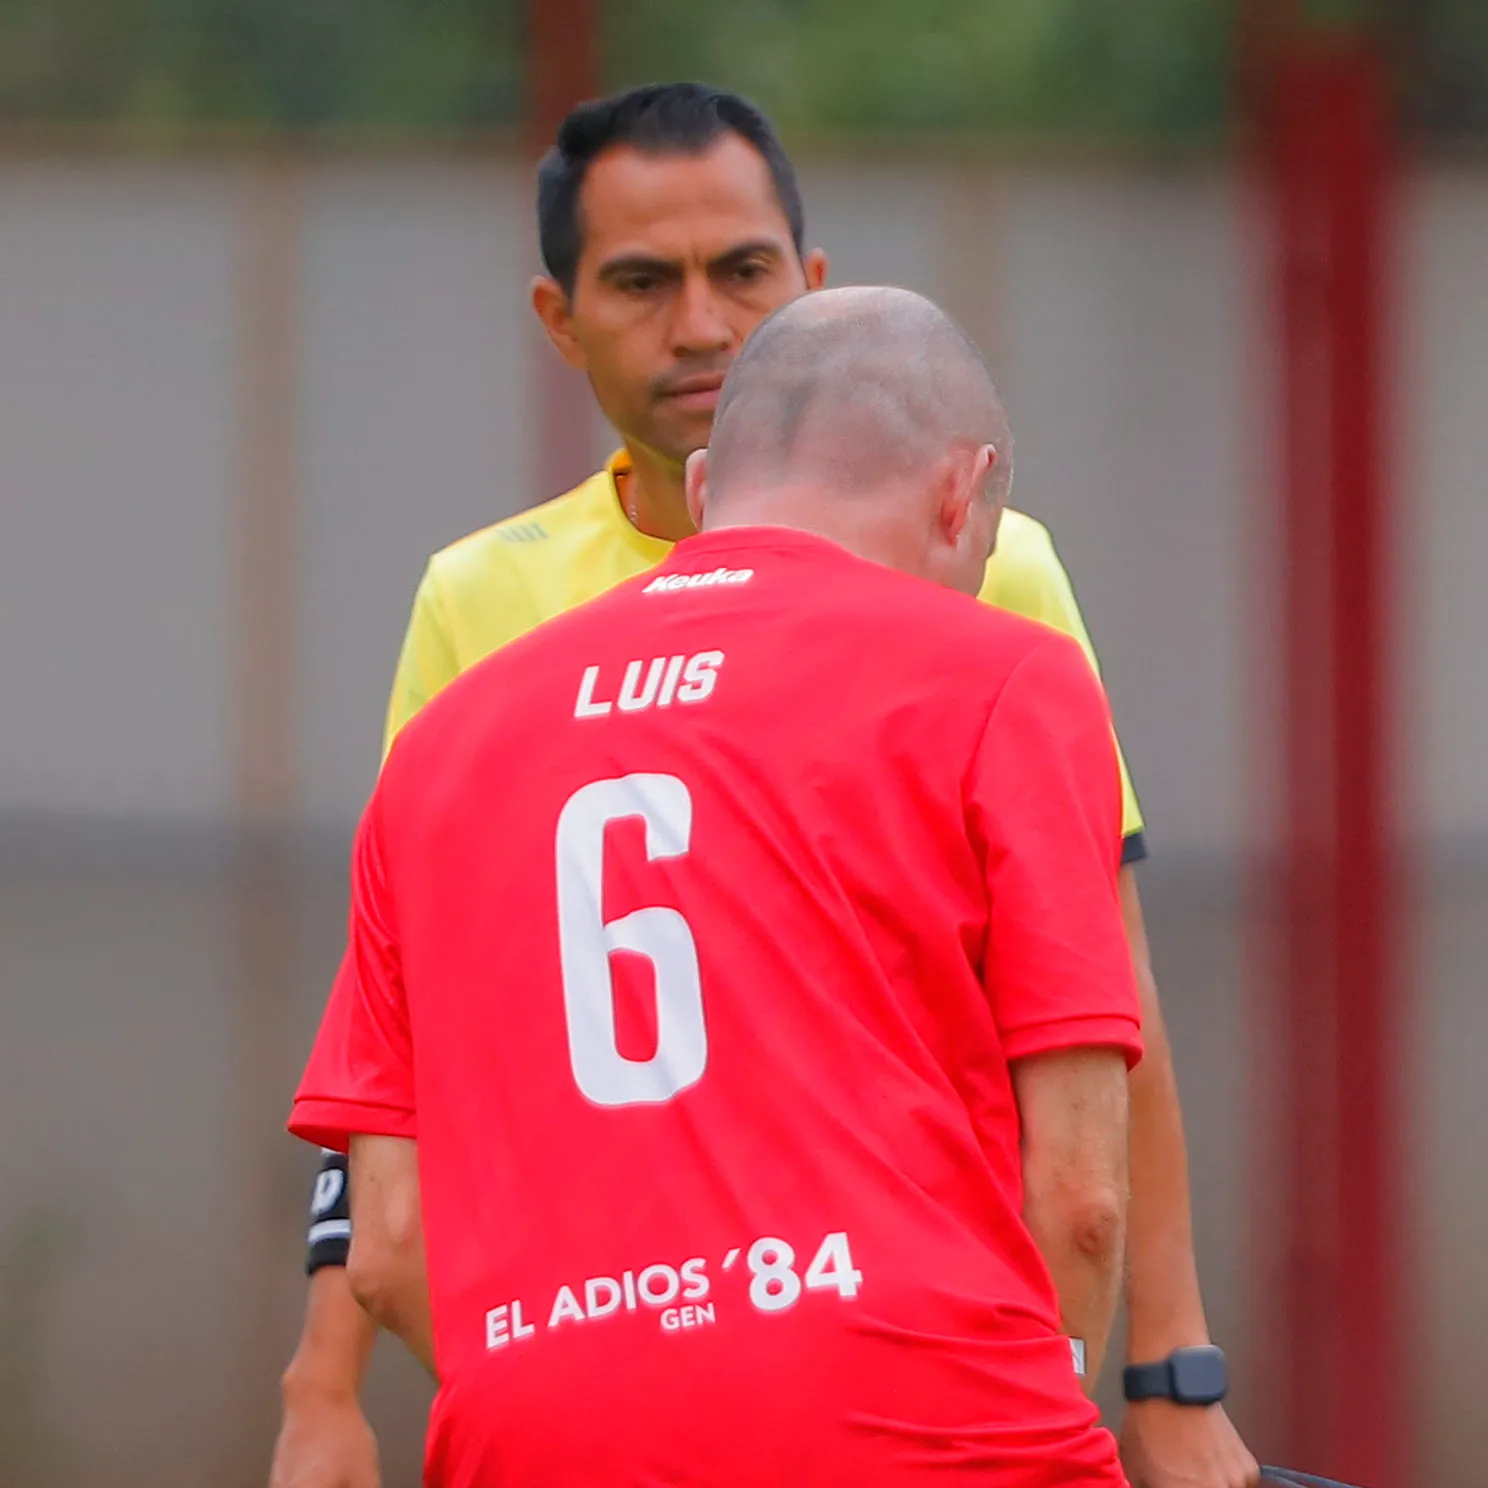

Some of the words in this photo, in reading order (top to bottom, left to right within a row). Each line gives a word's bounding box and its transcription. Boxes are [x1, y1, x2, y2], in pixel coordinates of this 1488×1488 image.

[641, 567, 755, 594] Keuka
[573, 649, 726, 718] LUIS
[554, 772, 709, 1106] 6
[486, 1299, 535, 1350] EL
[547, 1257, 711, 1328] ADIOS
[659, 1302, 717, 1332] GEN
